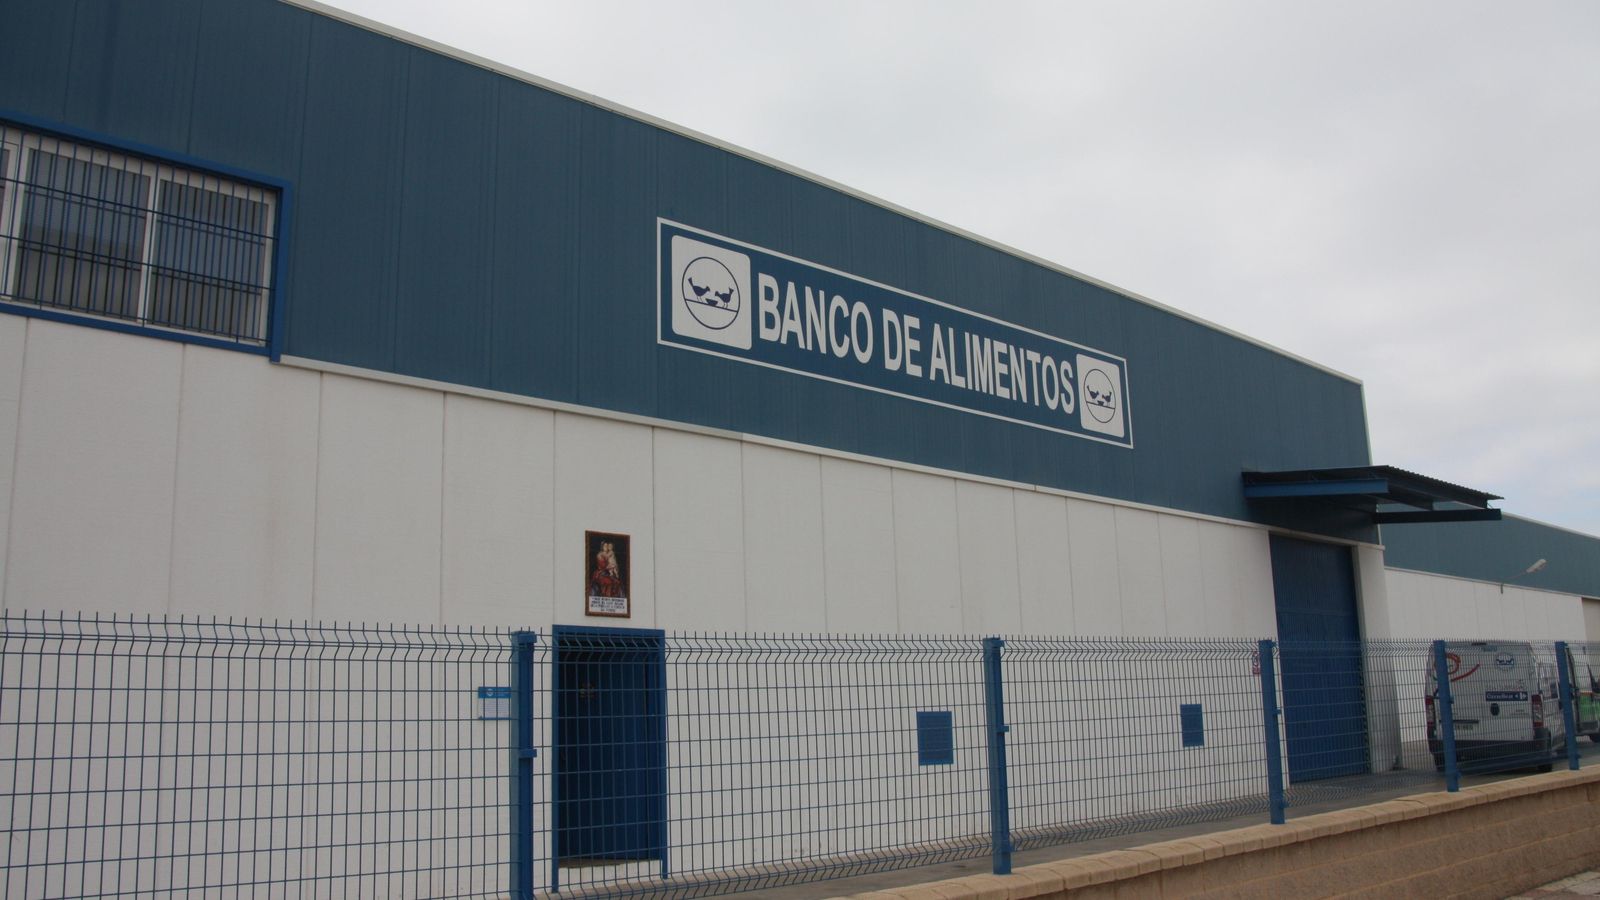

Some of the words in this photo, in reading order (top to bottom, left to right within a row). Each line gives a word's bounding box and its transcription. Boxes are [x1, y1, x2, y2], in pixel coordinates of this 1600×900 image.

[758, 272, 874, 364] BANCO
[882, 308, 923, 378] DE
[929, 322, 1075, 415] ALIMENTOS
